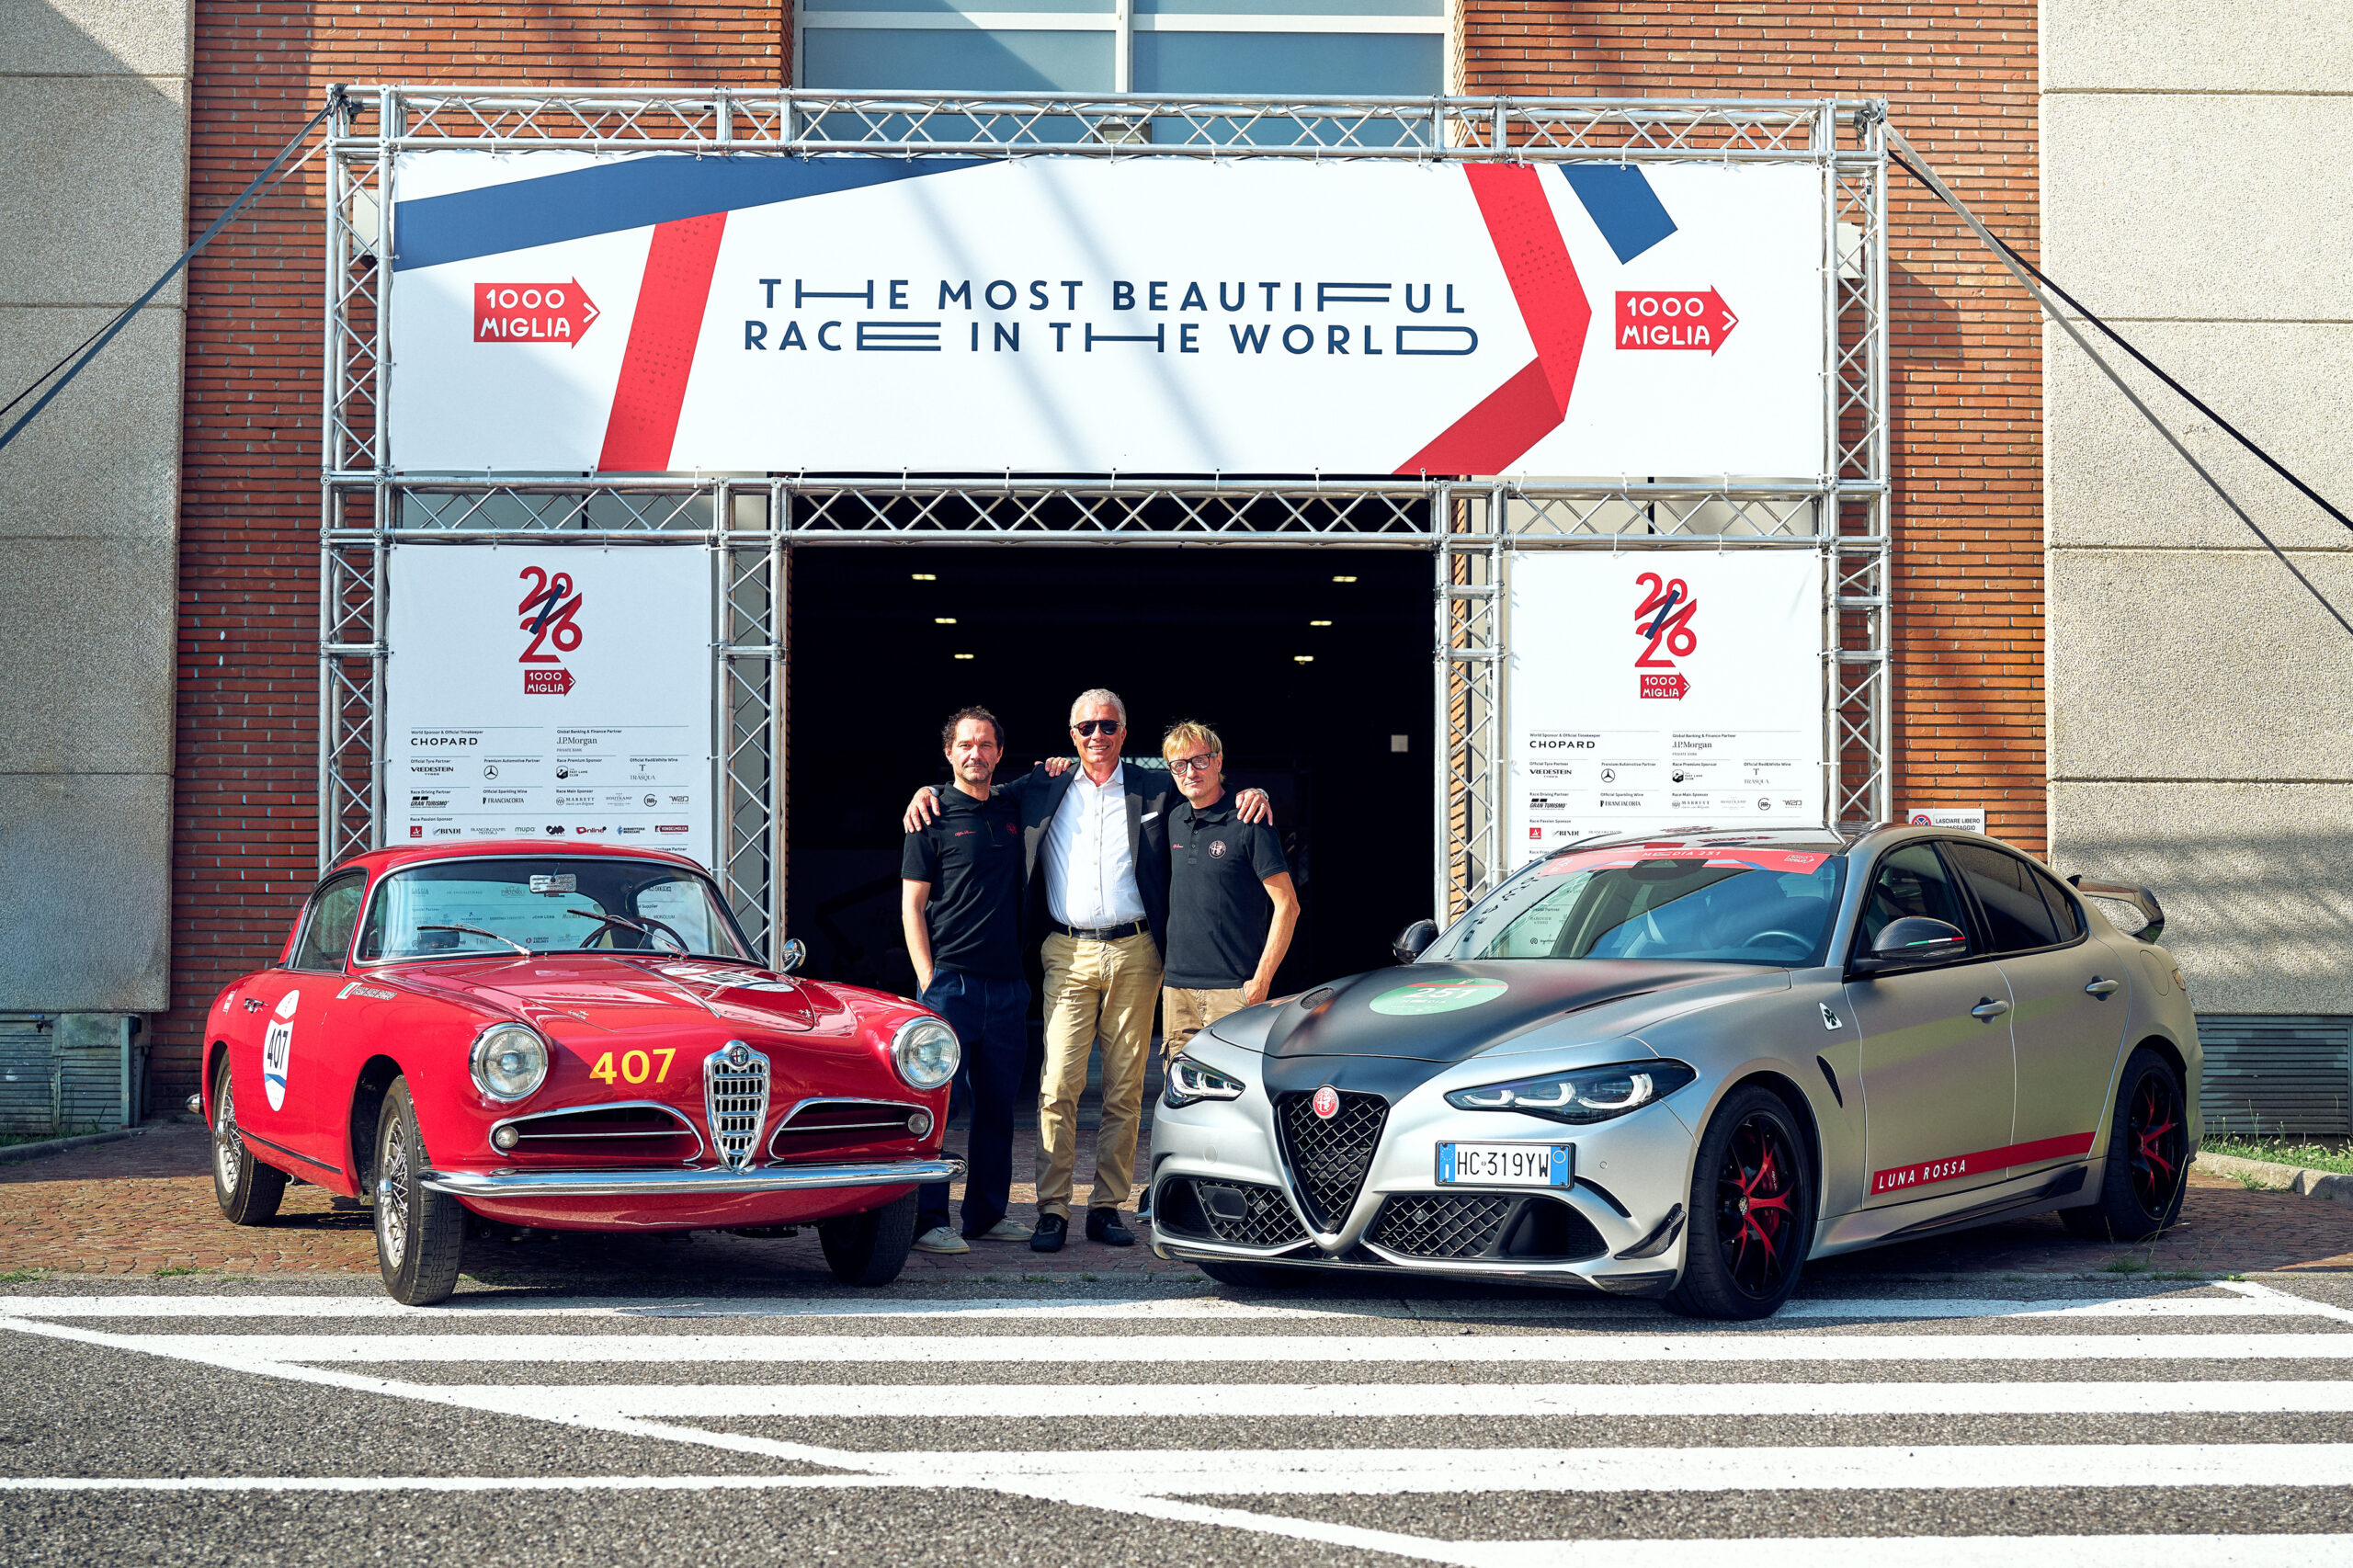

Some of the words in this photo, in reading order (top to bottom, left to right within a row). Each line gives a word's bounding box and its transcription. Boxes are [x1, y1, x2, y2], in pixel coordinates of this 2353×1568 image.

[485, 289, 565, 310] 1000
[759, 278, 908, 310] THE
[938, 279, 1083, 311] MOST
[1113, 280, 1465, 313] BEAUTIFUL
[1626, 297, 1704, 317] 1000
[480, 317, 571, 338] MIGLIA
[1621, 324, 1711, 346] MIGLIA
[745, 320, 942, 351] RACE
[972, 322, 1020, 352] IN
[1049, 322, 1199, 354] THE
[1230, 324, 1479, 356] WORLD
[529, 672, 563, 681] 1000
[1644, 676, 1677, 686] 1000
[527, 684, 564, 693] MIGLIA
[1643, 688, 1680, 697] MIGLIA
[411, 737, 478, 745] CHOPARD
[1529, 741, 1596, 749] CHOPARD
[1404, 988, 1478, 999] 251
[267, 1028, 289, 1070] 407
[589, 1048, 676, 1085] 407
[1879, 1169, 1915, 1190] LUNA
[1923, 1159, 1966, 1181] ROSSA
